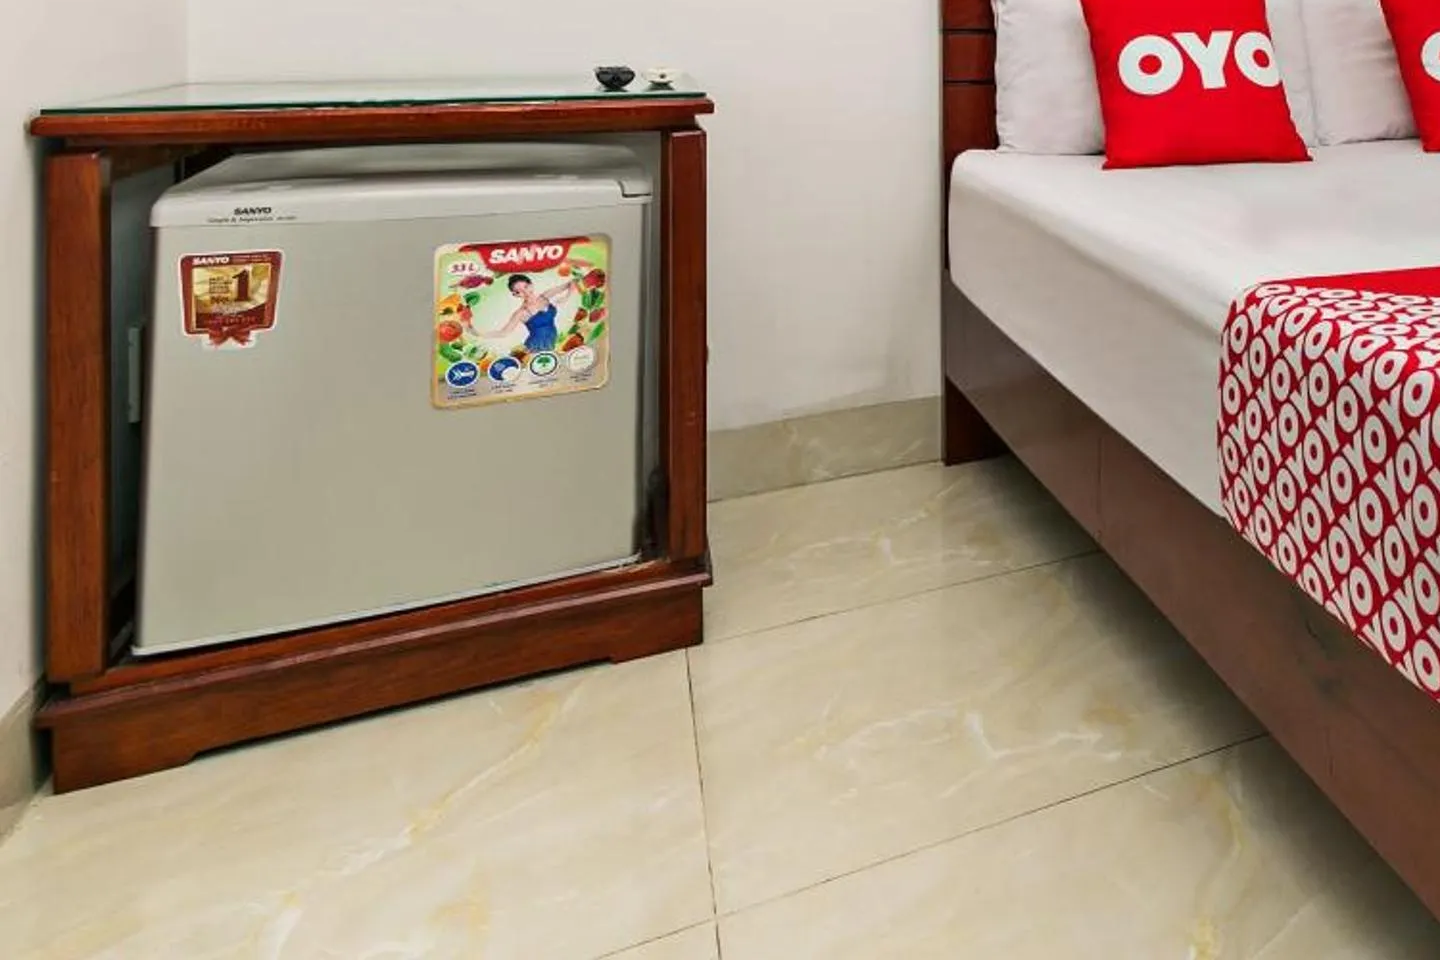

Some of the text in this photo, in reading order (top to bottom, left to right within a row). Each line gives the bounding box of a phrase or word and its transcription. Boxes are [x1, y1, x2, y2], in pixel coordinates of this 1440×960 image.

[1117, 30, 1281, 96] OYO
[234, 207, 271, 216] SANYO
[191, 257, 230, 266] SANYO
[489, 245, 563, 265] SANYO
